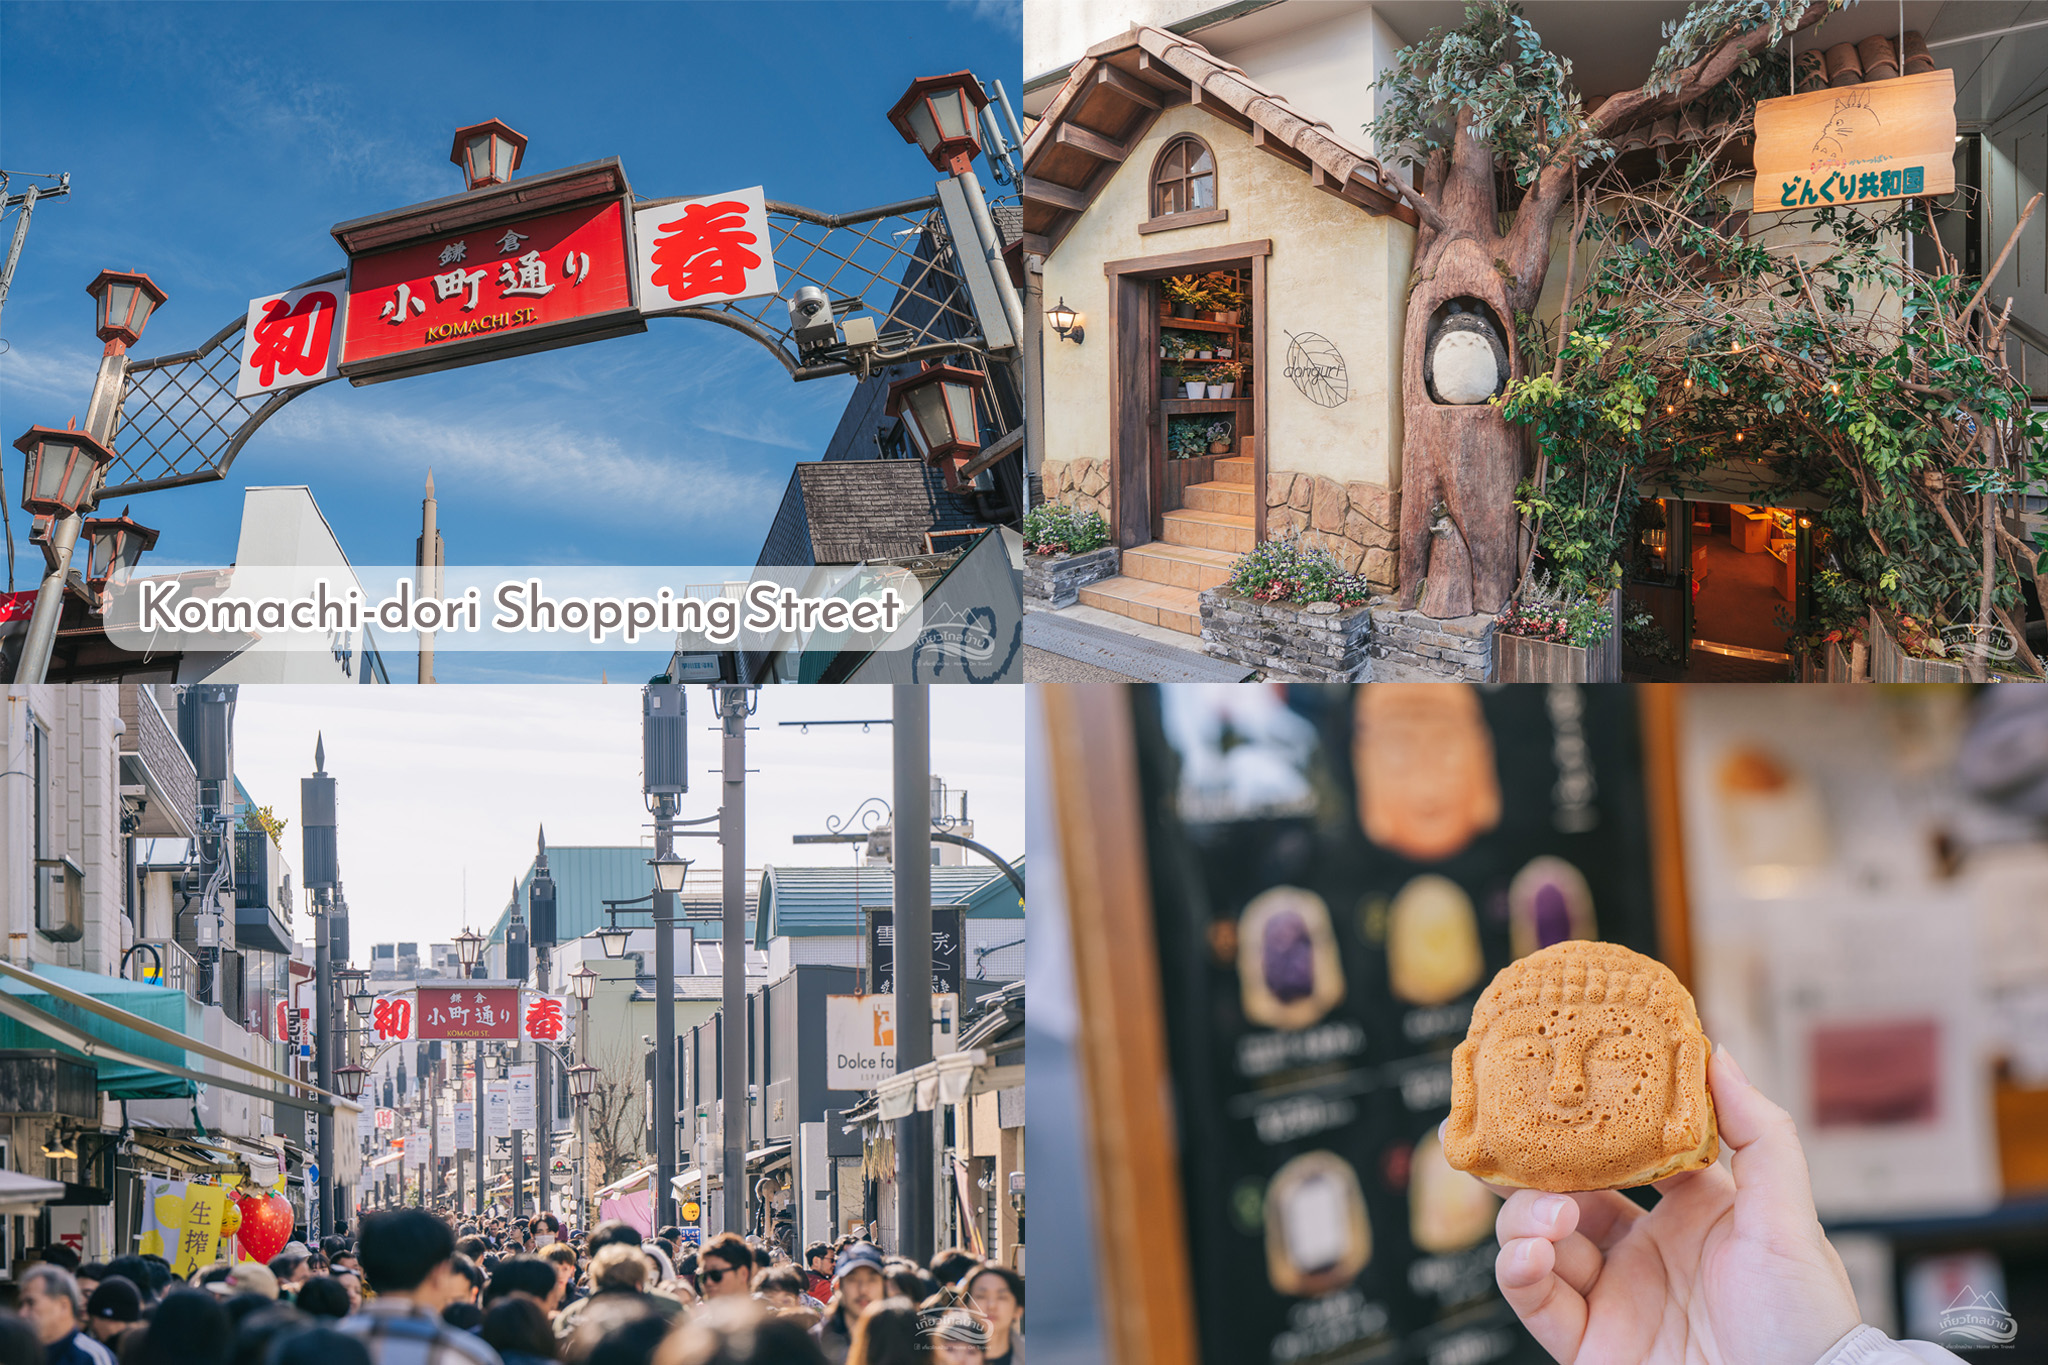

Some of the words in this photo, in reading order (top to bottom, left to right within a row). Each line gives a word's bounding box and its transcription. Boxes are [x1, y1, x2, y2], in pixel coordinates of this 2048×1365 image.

[1781, 166, 1924, 207] どんぐり共和国
[438, 229, 529, 267] 鎌倉
[651, 200, 762, 302] 春
[381, 250, 590, 323] 小町通り
[250, 290, 337, 388] 初
[427, 313, 510, 340] KOMACHI
[511, 306, 538, 324] ST.
[1283, 356, 1340, 385] donguri
[427, 1005, 510, 1027] 小町通り
[449, 992, 487, 1004] 鎌倉
[373, 998, 412, 1041] 初
[446, 1029, 477, 1037] KOMACHI
[478, 1029, 490, 1037] ST.
[525, 997, 563, 1041] 春
[837, 1052, 876, 1069] Dolce
[881, 1052, 894, 1069] fa
